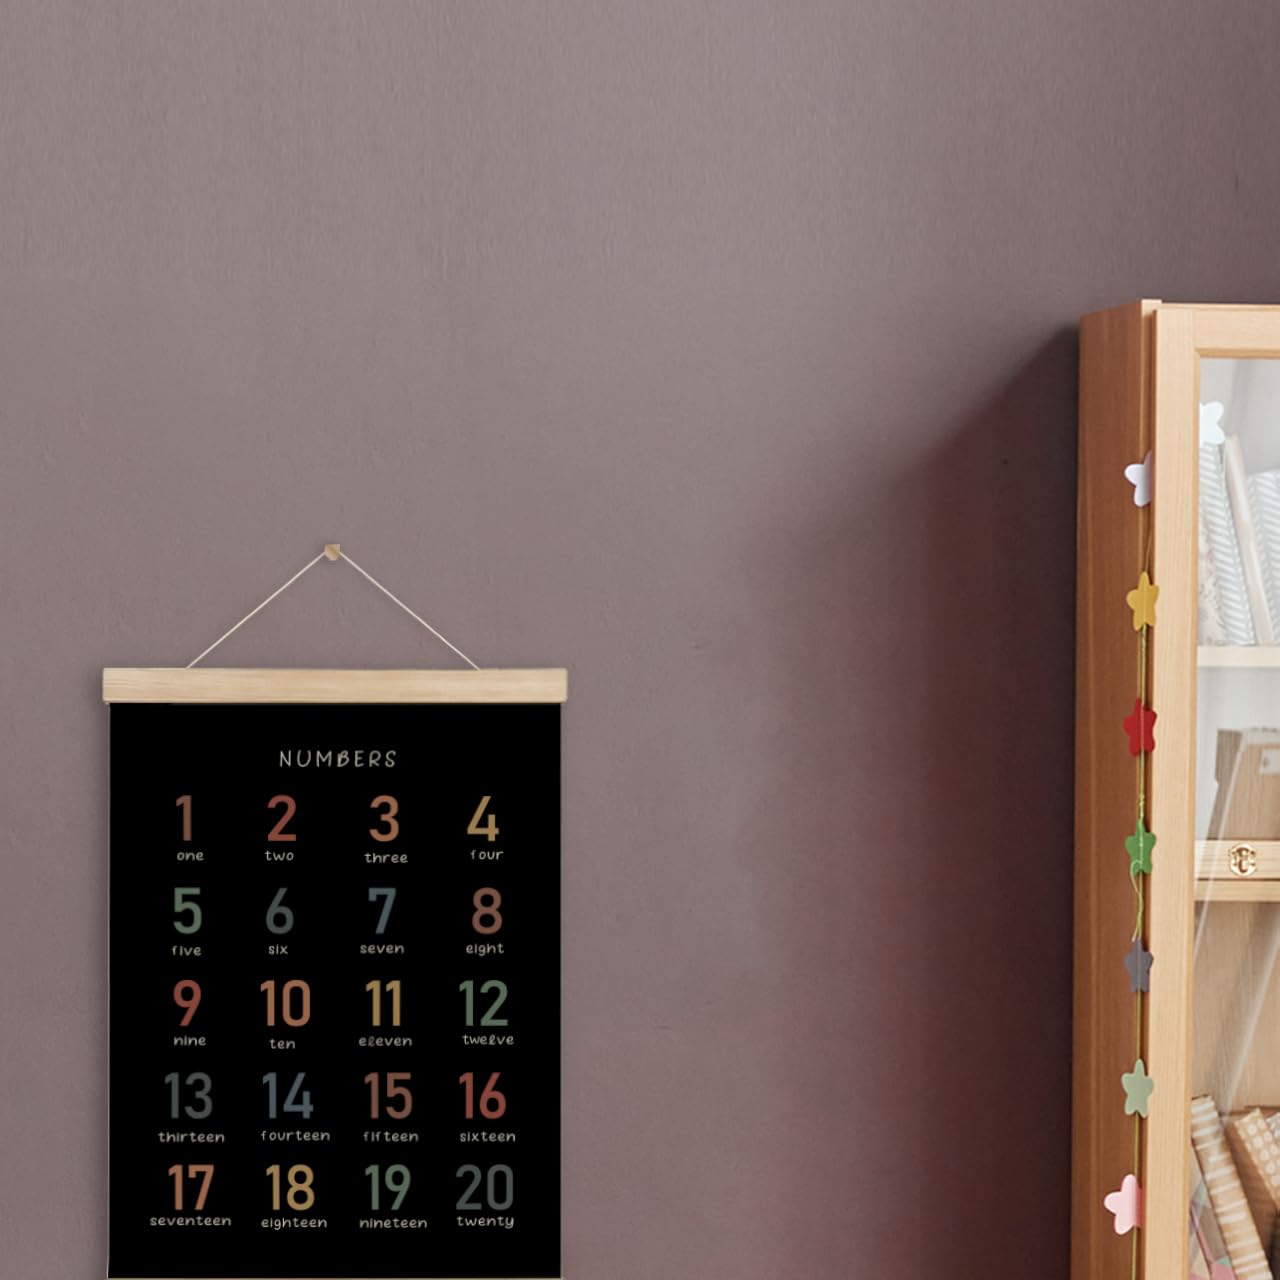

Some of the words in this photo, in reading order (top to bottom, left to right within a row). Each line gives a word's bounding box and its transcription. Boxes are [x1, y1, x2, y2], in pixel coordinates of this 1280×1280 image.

[279, 749, 397, 768] NUMBERS
[175, 794, 192, 842] 1
[267, 794, 297, 842] 2
[368, 794, 400, 843] 3
[466, 795, 500, 842] 4
[176, 851, 204, 862] one
[264, 849, 295, 862] two
[363, 852, 409, 864] three
[470, 849, 504, 861] four
[173, 887, 202, 935] 5
[265, 887, 294, 934] 6
[368, 887, 397, 934] 7
[471, 886, 503, 935] 8
[171, 945, 202, 957] five
[268, 943, 289, 956] six
[359, 944, 405, 955] seven
[465, 943, 505, 957] eight
[172, 979, 202, 1027] 9
[259, 979, 311, 1028] 10
[365, 979, 401, 1027] 11
[459, 979, 509, 1027] 12
[173, 1035, 207, 1047] nine
[269, 1038, 296, 1050] ten
[358, 1035, 413, 1047] eleven
[462, 1033, 514, 1046] twelve
[164, 1072, 213, 1119] 13
[262, 1072, 314, 1119] 14
[364, 1071, 413, 1120] 15
[458, 1071, 507, 1120] 16
[157, 1131, 225, 1143] thirteen
[260, 1129, 331, 1142] fourteen
[363, 1130, 419, 1143] fifteen
[459, 1131, 516, 1143] sixteen
[167, 1163, 215, 1211] 17
[265, 1163, 316, 1212] 18
[364, 1163, 411, 1211] 19
[455, 1164, 514, 1211] 20
[149, 1215, 232, 1227] seventeen
[260, 1216, 328, 1231] eighteen
[359, 1217, 428, 1229] nineteen
[456, 1215, 515, 1230] twenty
